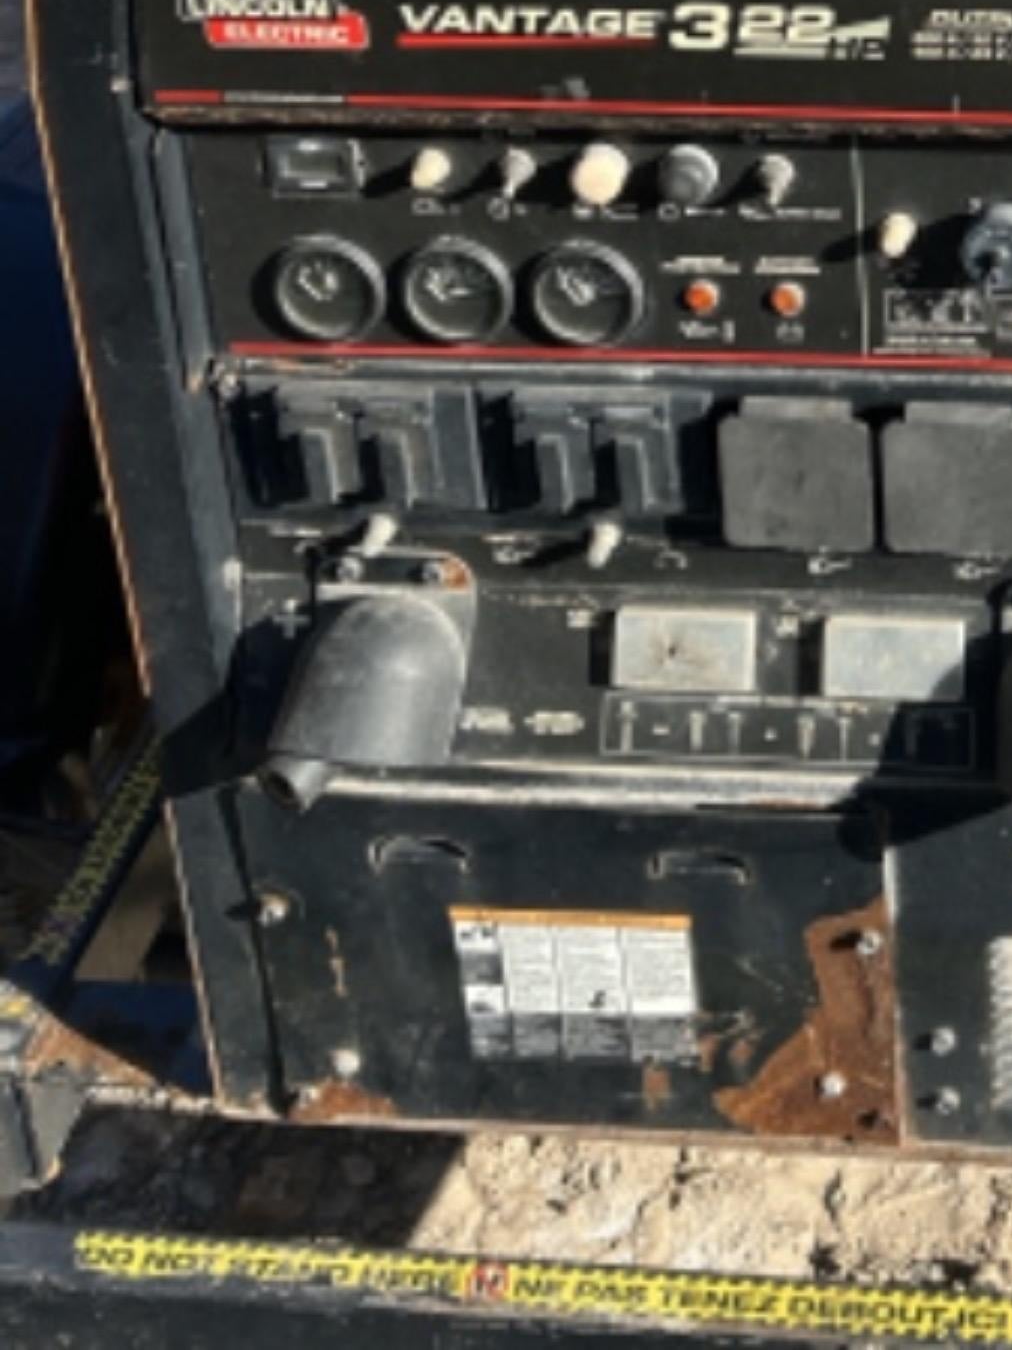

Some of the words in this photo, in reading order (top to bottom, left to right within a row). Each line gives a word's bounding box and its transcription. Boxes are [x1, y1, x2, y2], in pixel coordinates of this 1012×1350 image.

[221, 20, 350, 45] ELECTRIC
[399, 3, 664, 39] VANTAGE
[669, 1, 836, 51] 322
